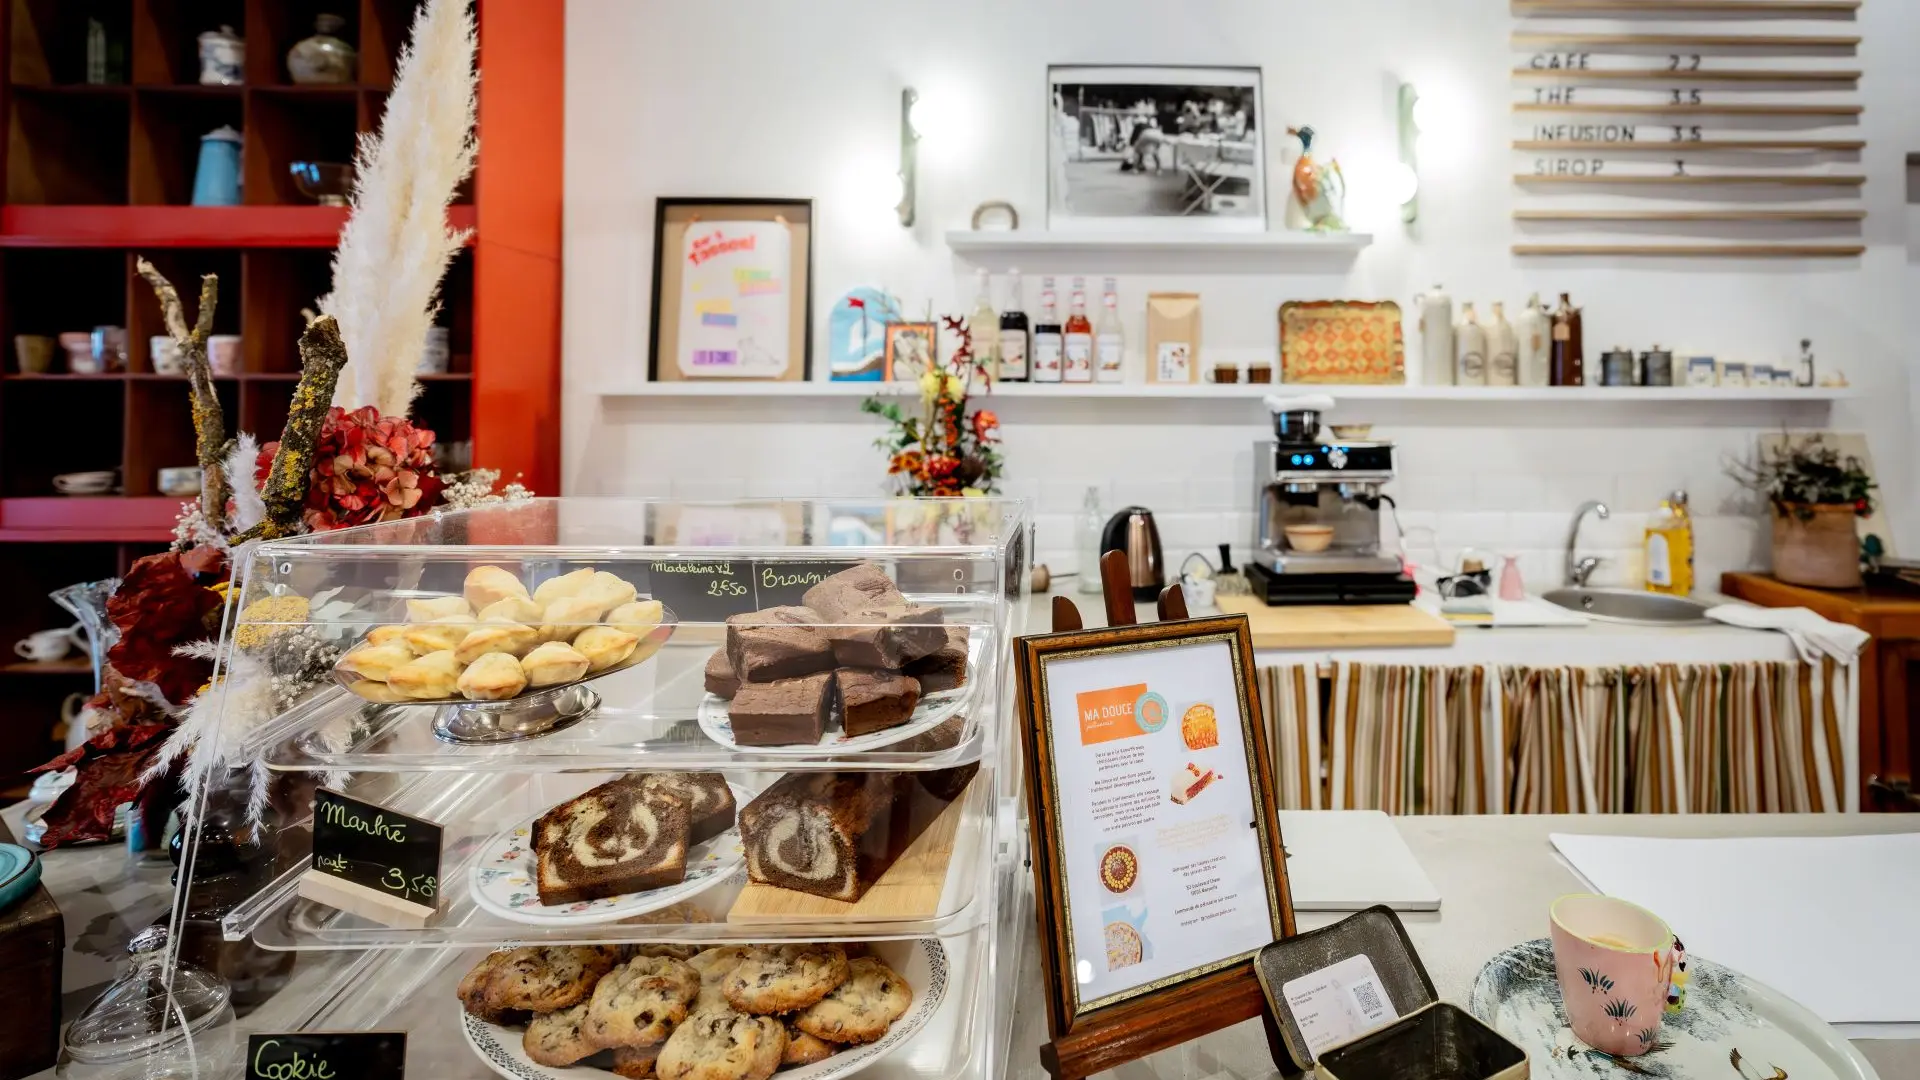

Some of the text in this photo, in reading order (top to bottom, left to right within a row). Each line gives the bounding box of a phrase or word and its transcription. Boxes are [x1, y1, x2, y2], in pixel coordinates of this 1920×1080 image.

[1533, 125, 1636, 142] INFUSION
[1534, 159, 1604, 176] SIROP
[650, 560, 715, 575] Madeleine
[707, 580, 748, 597] 2€50
[1083, 703, 1133, 722] MA DOUCE
[320, 801, 407, 843] Marbré
[254, 1039, 336, 1080] Cookie
